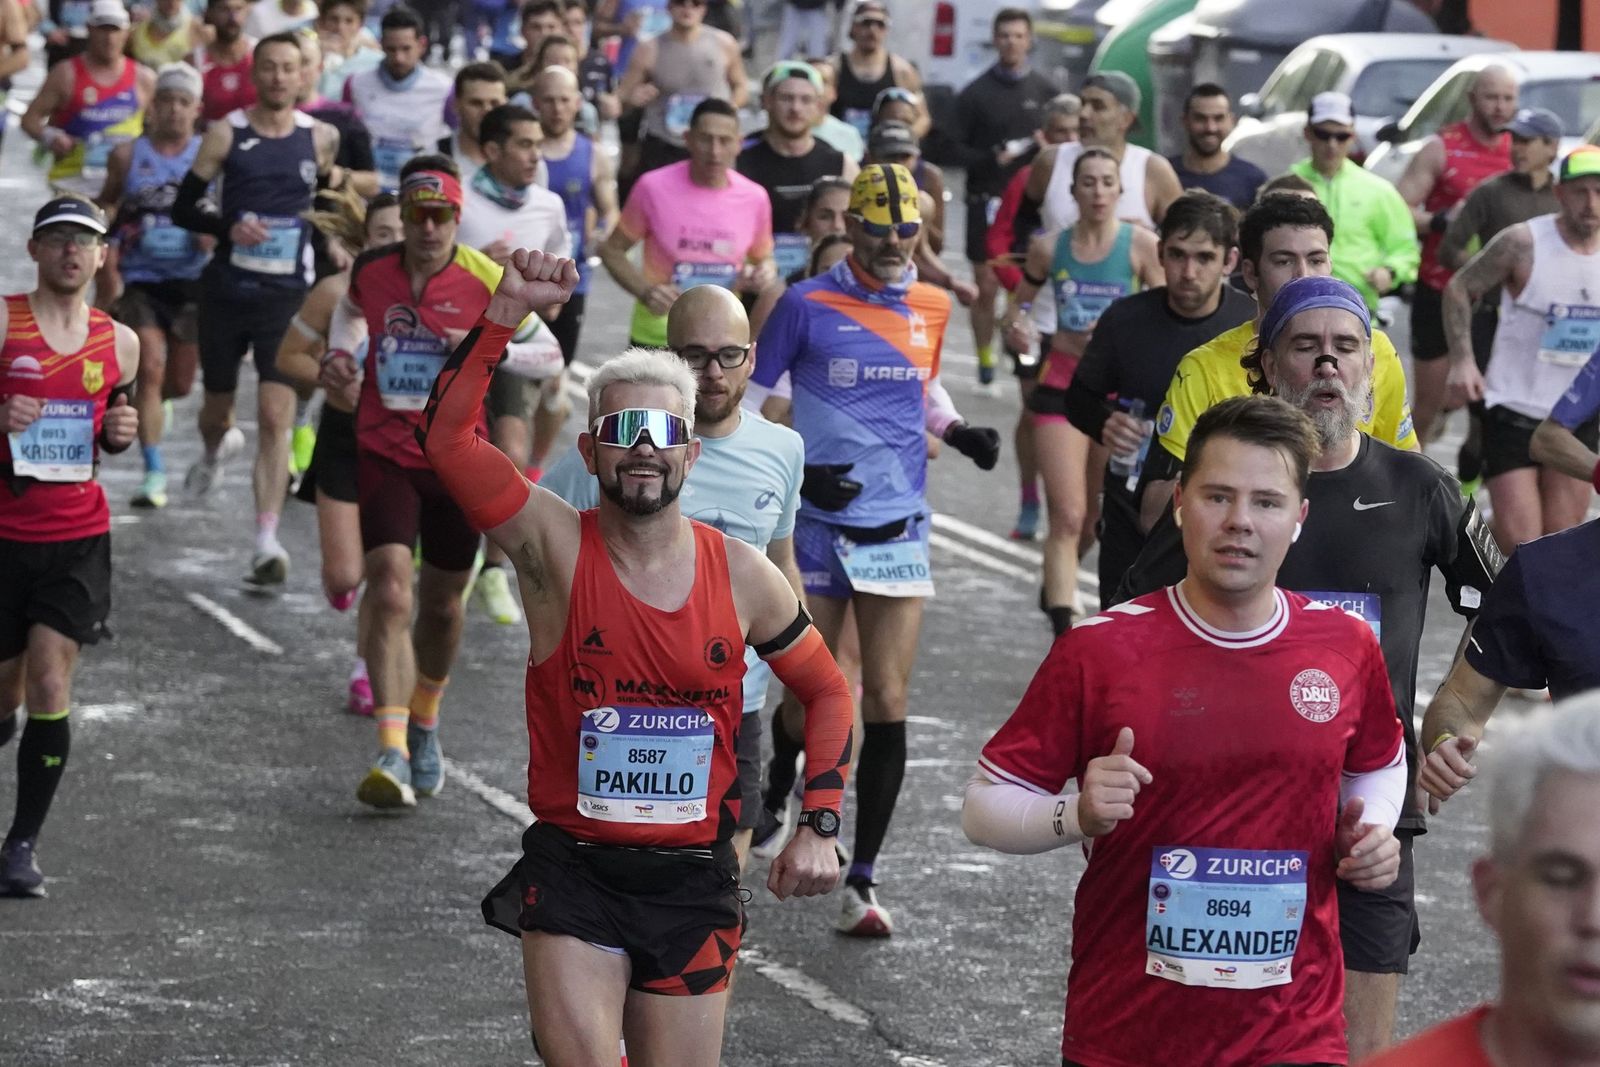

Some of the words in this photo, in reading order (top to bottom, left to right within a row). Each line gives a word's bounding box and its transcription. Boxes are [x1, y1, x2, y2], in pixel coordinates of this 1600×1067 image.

[20, 444, 85, 460] KRISTOF
[1300, 686, 1331, 702] DBU
[628, 714, 700, 730] ZURICH
[628, 748, 667, 764] 8587
[594, 769, 694, 795] PAKILLO
[1206, 857, 1289, 876] ZURICH
[1206, 899, 1251, 918] 8694
[1148, 925, 1298, 956] ALEXANDER
